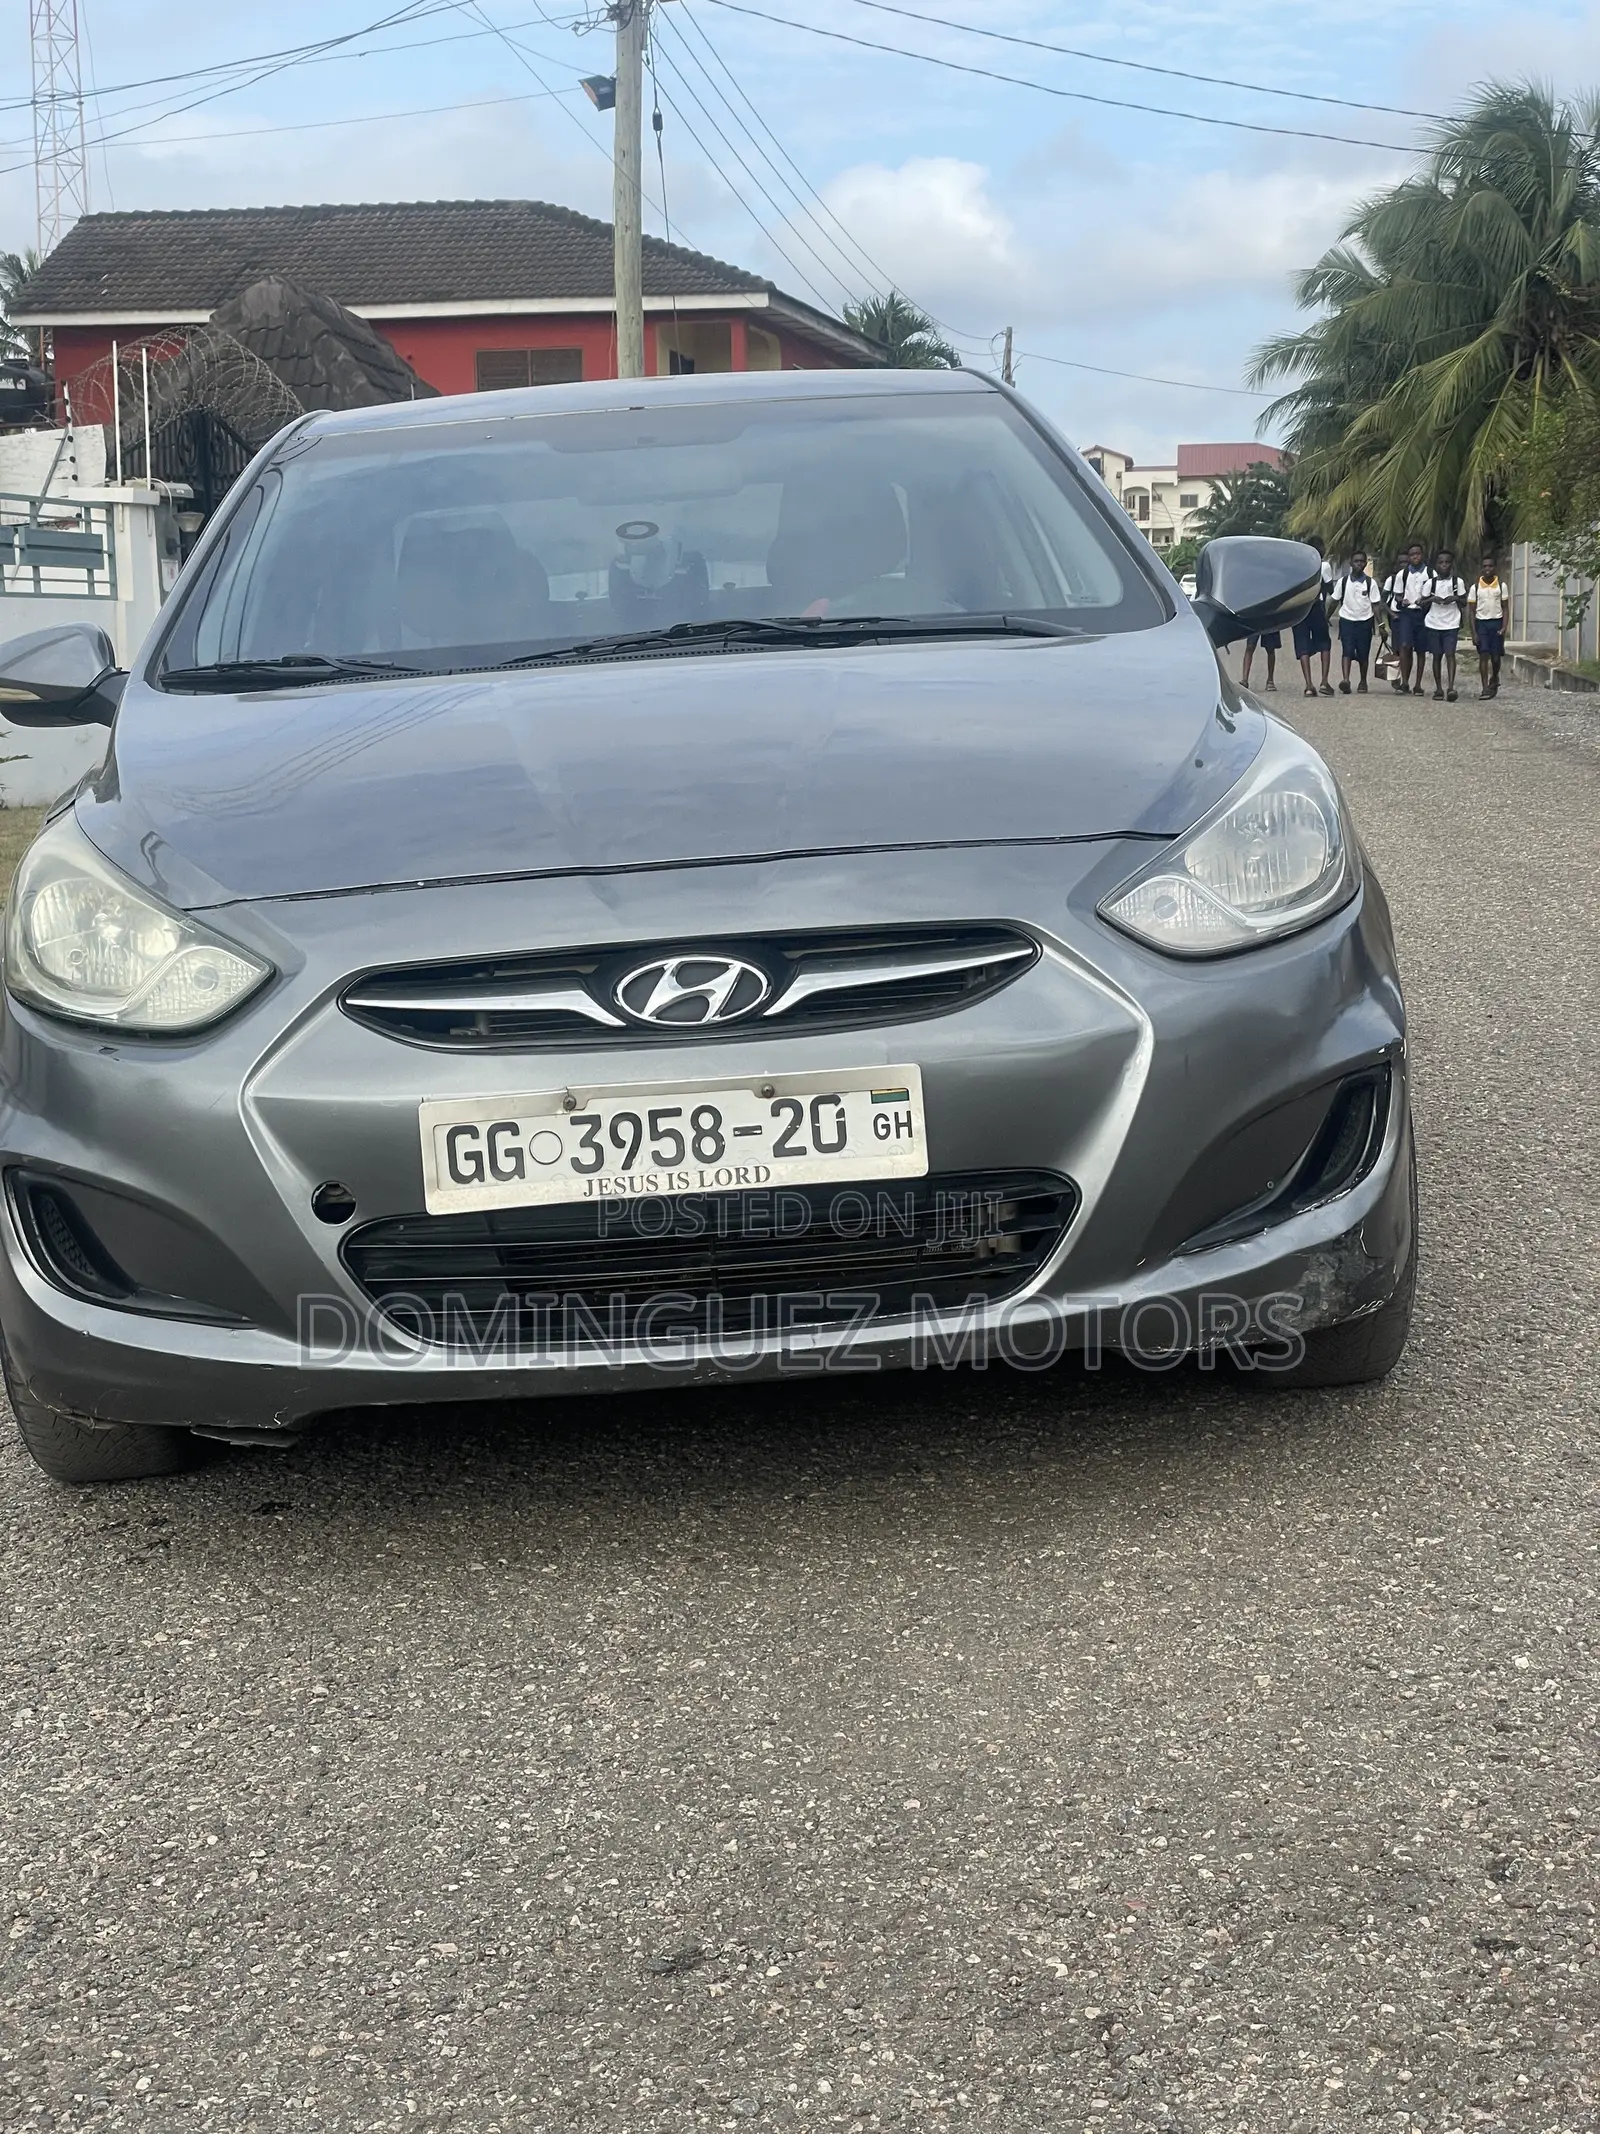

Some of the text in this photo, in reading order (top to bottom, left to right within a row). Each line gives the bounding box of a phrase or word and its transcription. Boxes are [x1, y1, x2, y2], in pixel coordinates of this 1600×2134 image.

[873, 1110, 913, 1140] GH
[446, 1122, 526, 1184] GG
[583, 1165, 771, 1198] JESUS IS LORD
